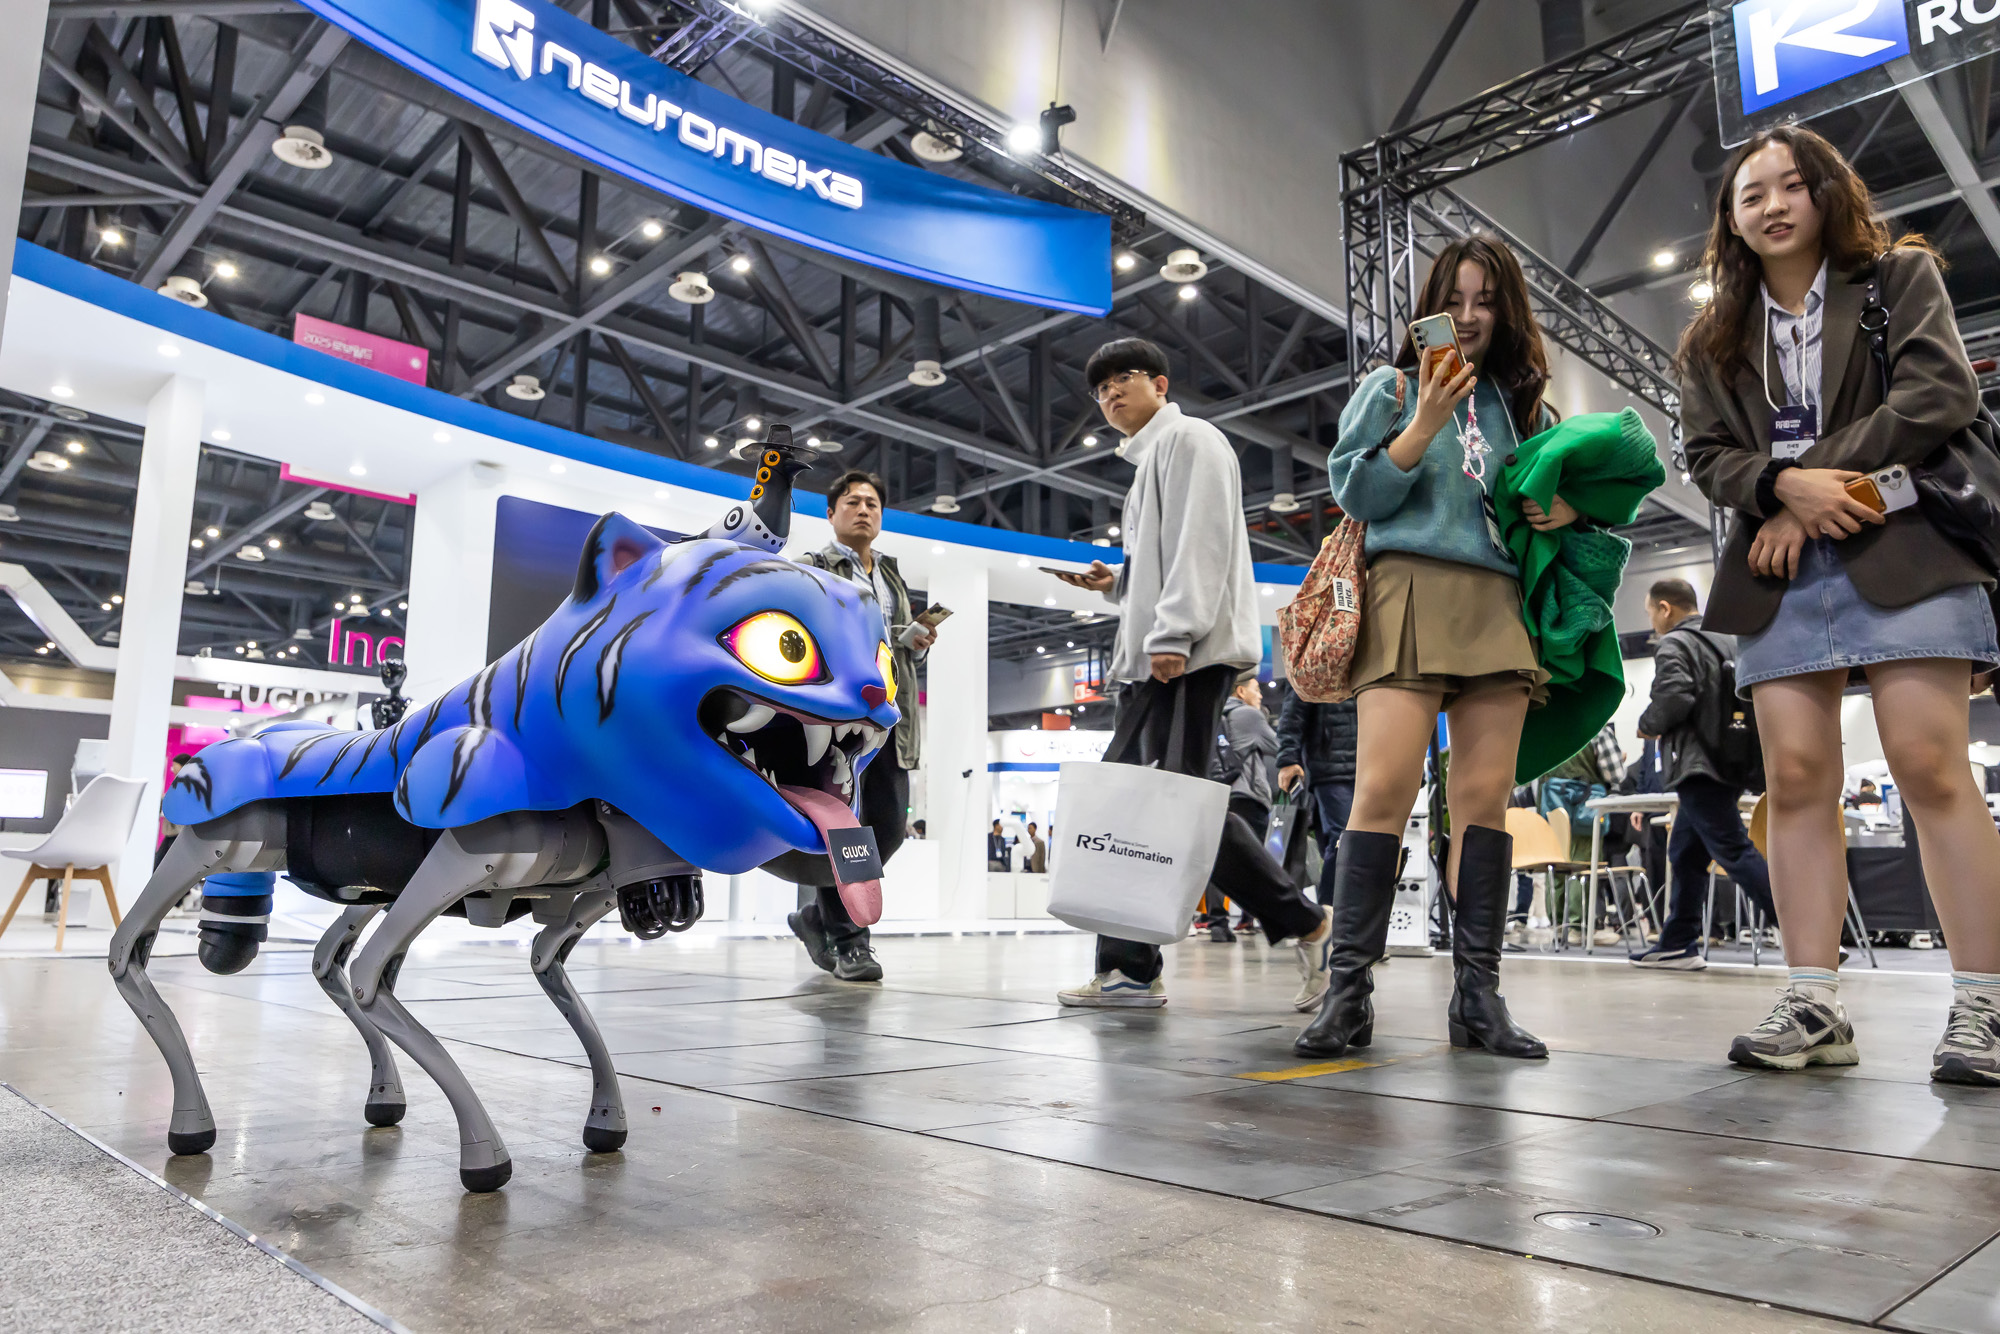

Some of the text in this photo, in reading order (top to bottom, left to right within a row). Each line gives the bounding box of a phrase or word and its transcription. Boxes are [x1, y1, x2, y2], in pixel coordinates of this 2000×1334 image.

[540, 41, 863, 210] neuromeka
[842, 844, 870, 859] GLUCK
[1076, 833, 1106, 852] RS
[1108, 844, 1173, 865] Automation
[1974, 995, 1991, 1005] NIKE
